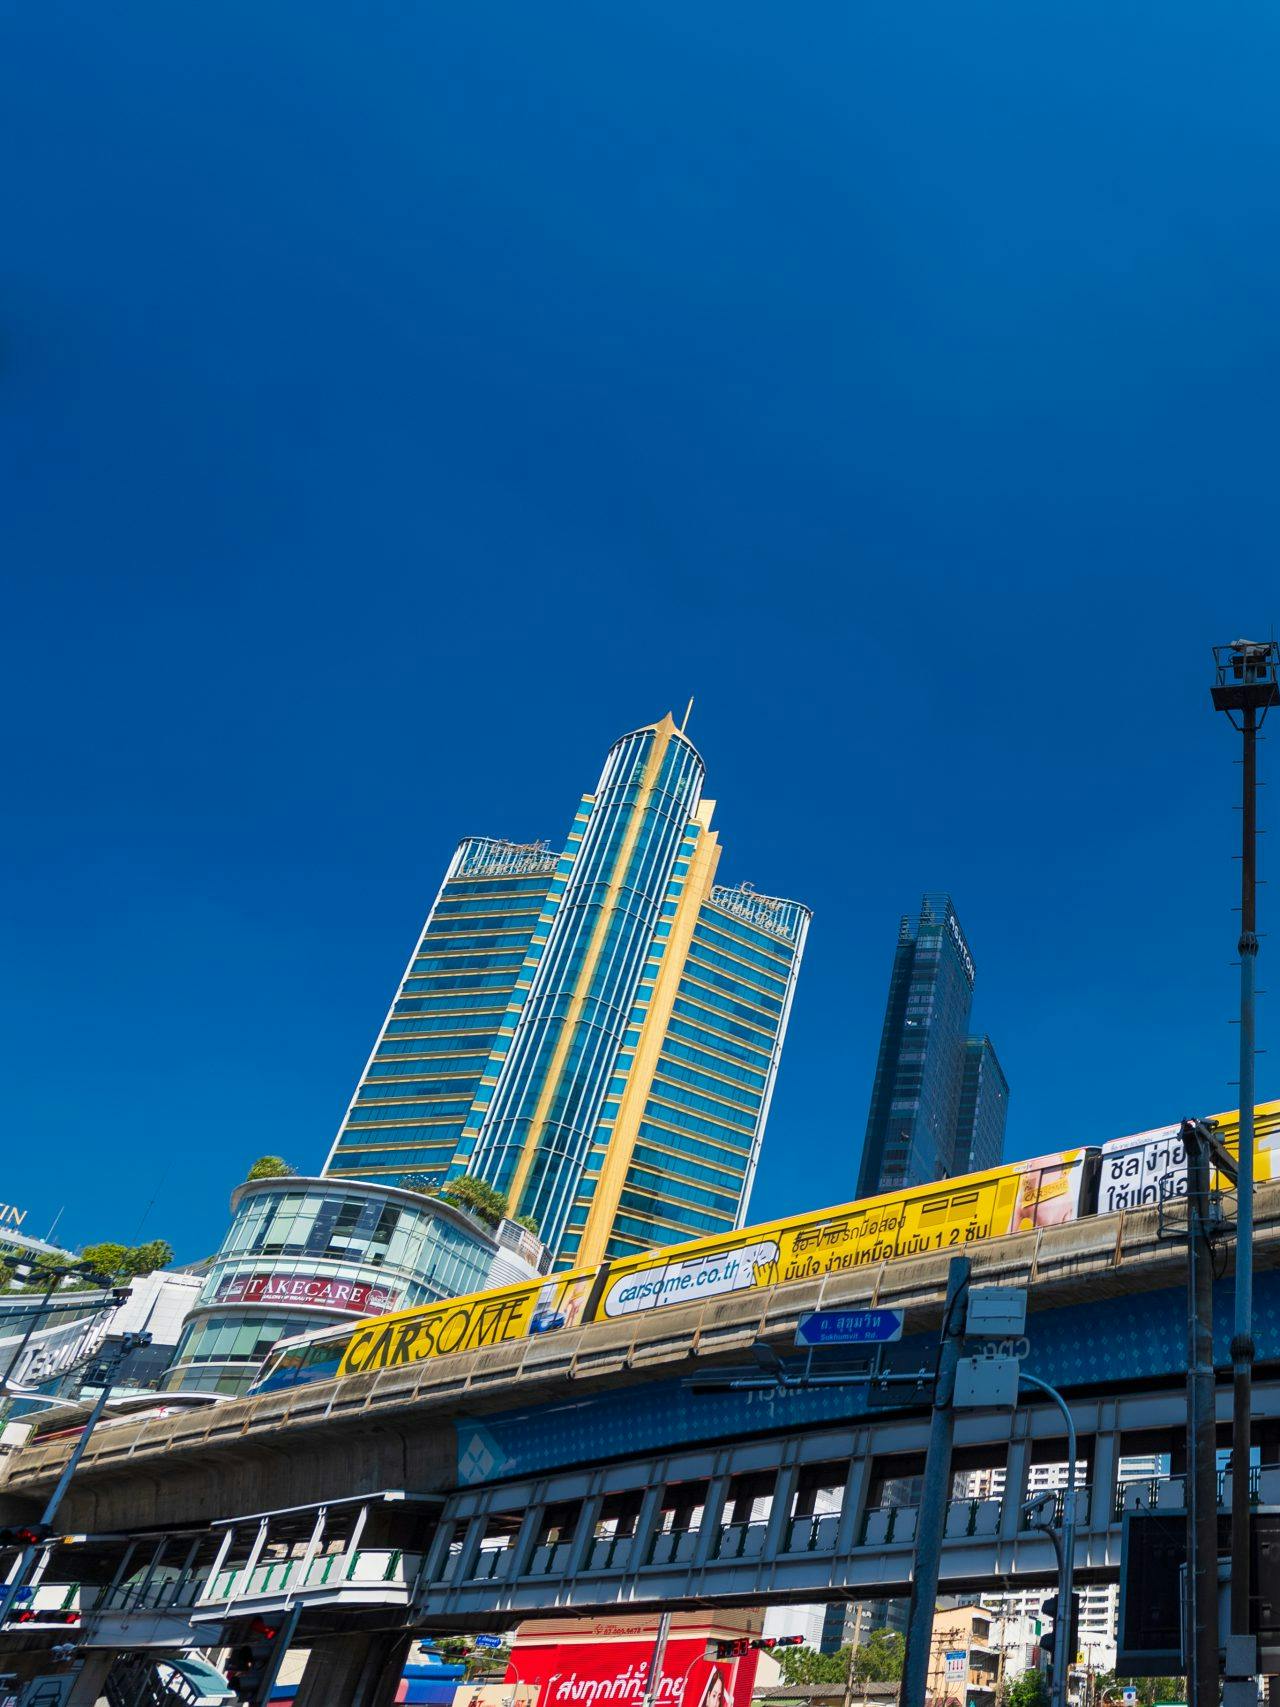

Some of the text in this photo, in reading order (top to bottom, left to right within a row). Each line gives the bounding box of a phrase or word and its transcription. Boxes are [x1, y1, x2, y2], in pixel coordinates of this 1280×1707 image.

[249, 1279, 364, 1303] TAKECARE
[620, 1260, 740, 1304] carsome.co.th
[345, 1297, 524, 1373] CARSOME
[820, 1333, 860, 1342] Sukhumvit
